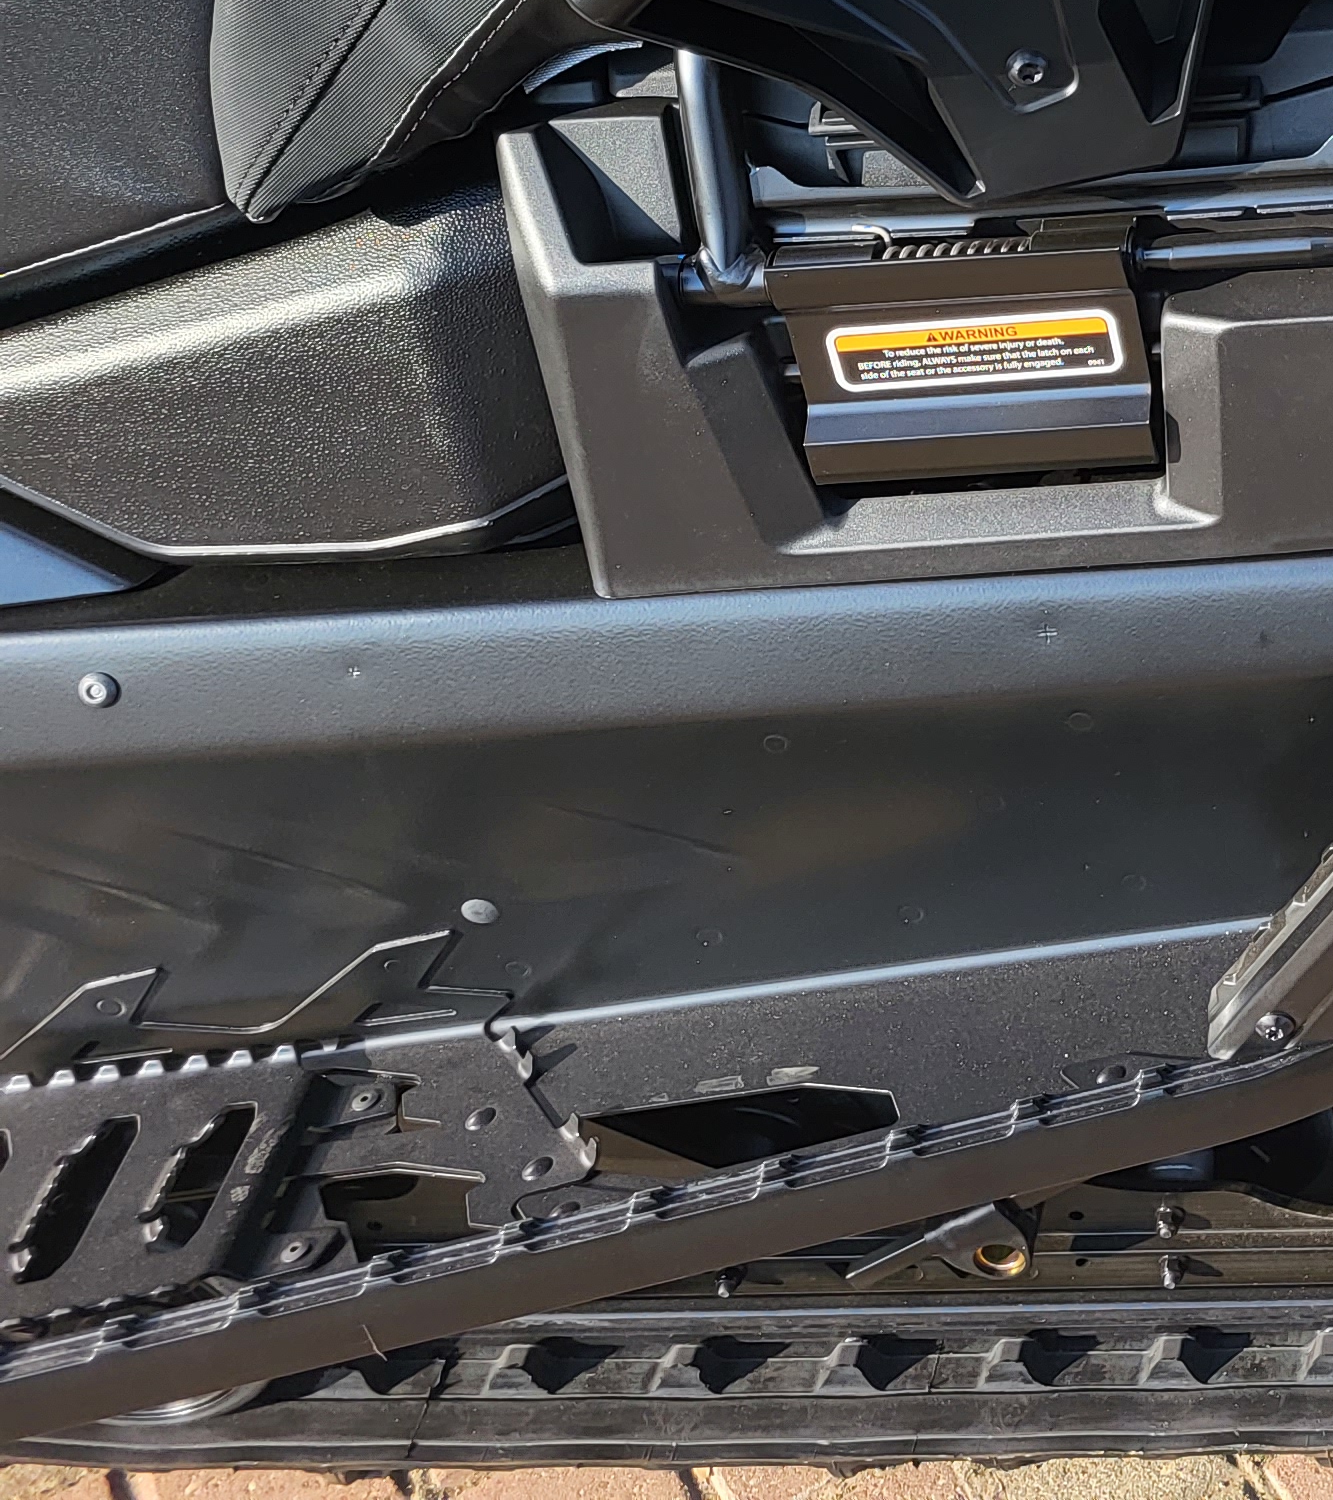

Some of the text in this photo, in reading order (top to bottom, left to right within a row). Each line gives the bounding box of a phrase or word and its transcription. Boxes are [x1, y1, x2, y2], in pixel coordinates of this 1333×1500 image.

[939, 326, 1018, 342] WARNING
[857, 360, 892, 371] BEFORE
[922, 356, 957, 366] ALWAYS
[958, 354, 982, 363] make
[983, 353, 1002, 361] sure
[1002, 351, 1021, 360] that
[1022, 350, 1037, 358] the
[1037, 348, 1059, 357] latch
[1060, 348, 1073, 356] on
[1074, 345, 1095, 355] each
[882, 350, 895, 358] To
[896, 348, 926, 357] reduce
[927, 346, 942, 355] the
[943, 345, 958, 354] risk
[960, 344, 969, 352] of
[970, 343, 998, 351] severe
[999, 341, 1024, 350] injury
[1036, 337, 1065, 347] death.
[860, 371, 879, 381] side
[880, 370, 890, 378] of
[890, 369, 905, 378] the
[906, 368, 925, 377] seat
[926, 368, 936, 376] or
[936, 366, 952, 375] the
[953, 363, 994, 374] accessory
[995, 362, 1003, 370] is
[1003, 360, 1023, 370] fully
